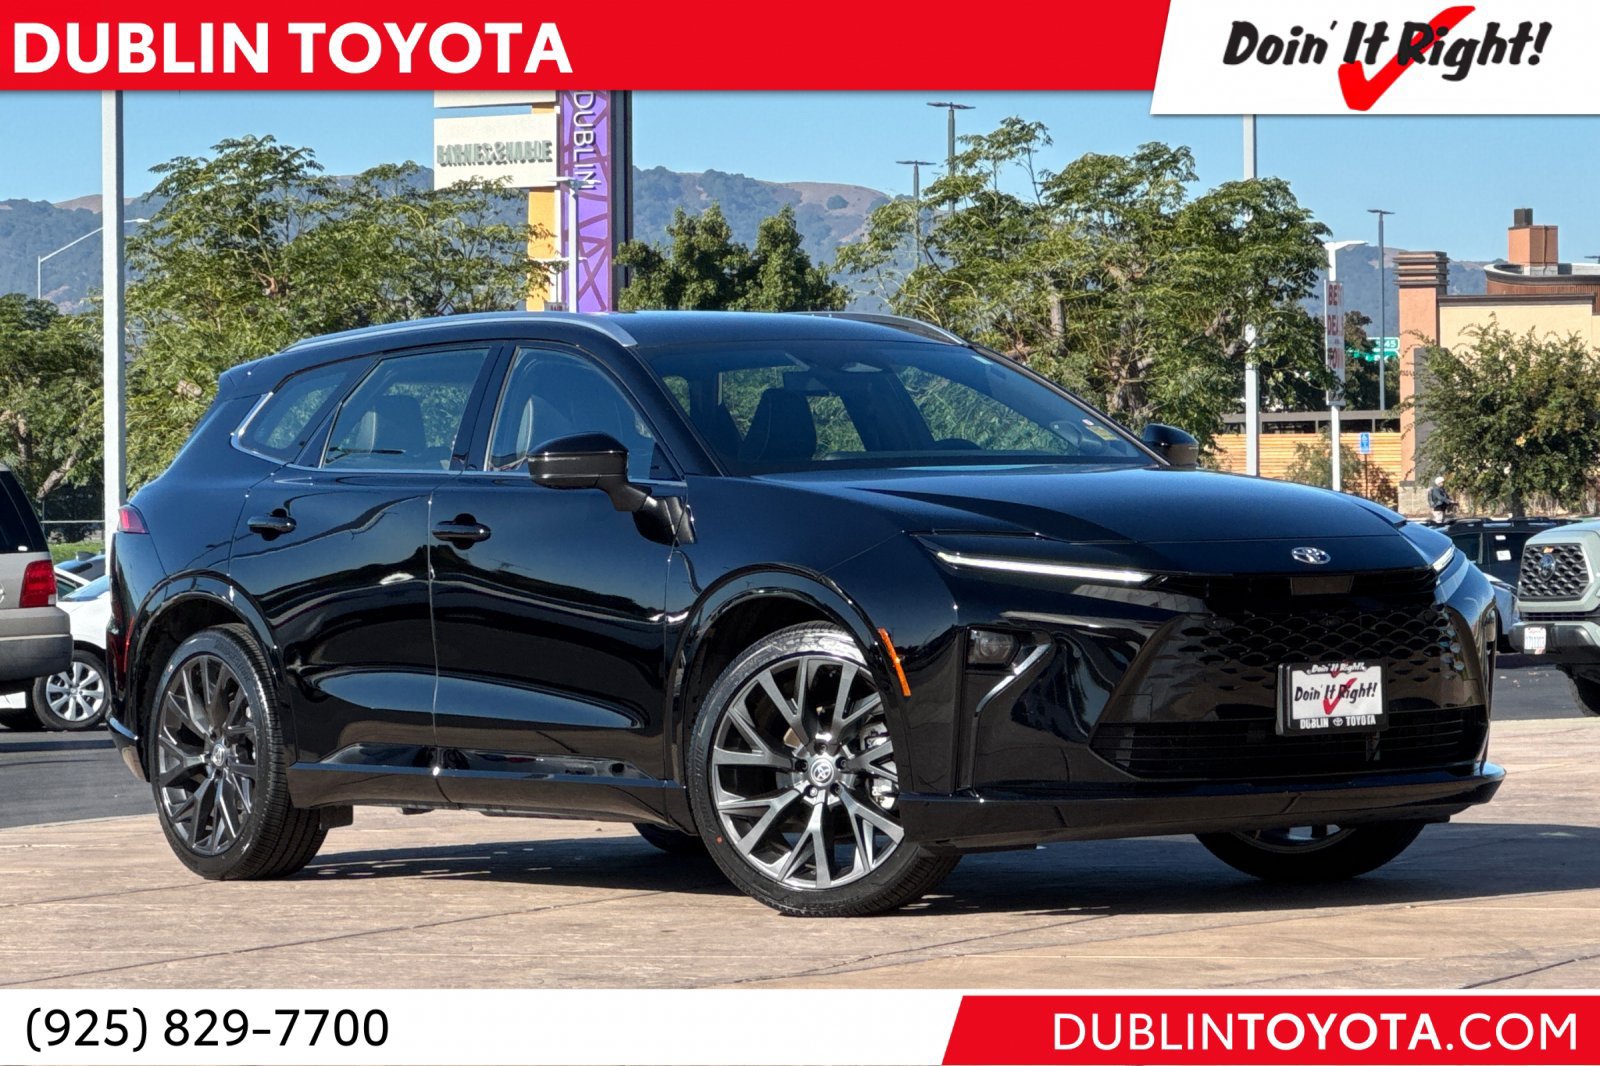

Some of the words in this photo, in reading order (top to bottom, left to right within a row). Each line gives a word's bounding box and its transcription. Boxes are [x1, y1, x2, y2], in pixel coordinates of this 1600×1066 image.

[573, 91, 597, 190] DUBLIN
[1295, 685, 1323, 701] Doin'
[1324, 684, 1336, 699] It
[1338, 682, 1378, 704] Right!
[1300, 718, 1329, 729] DUBLIN
[1346, 714, 1377, 727] TOYOTA
